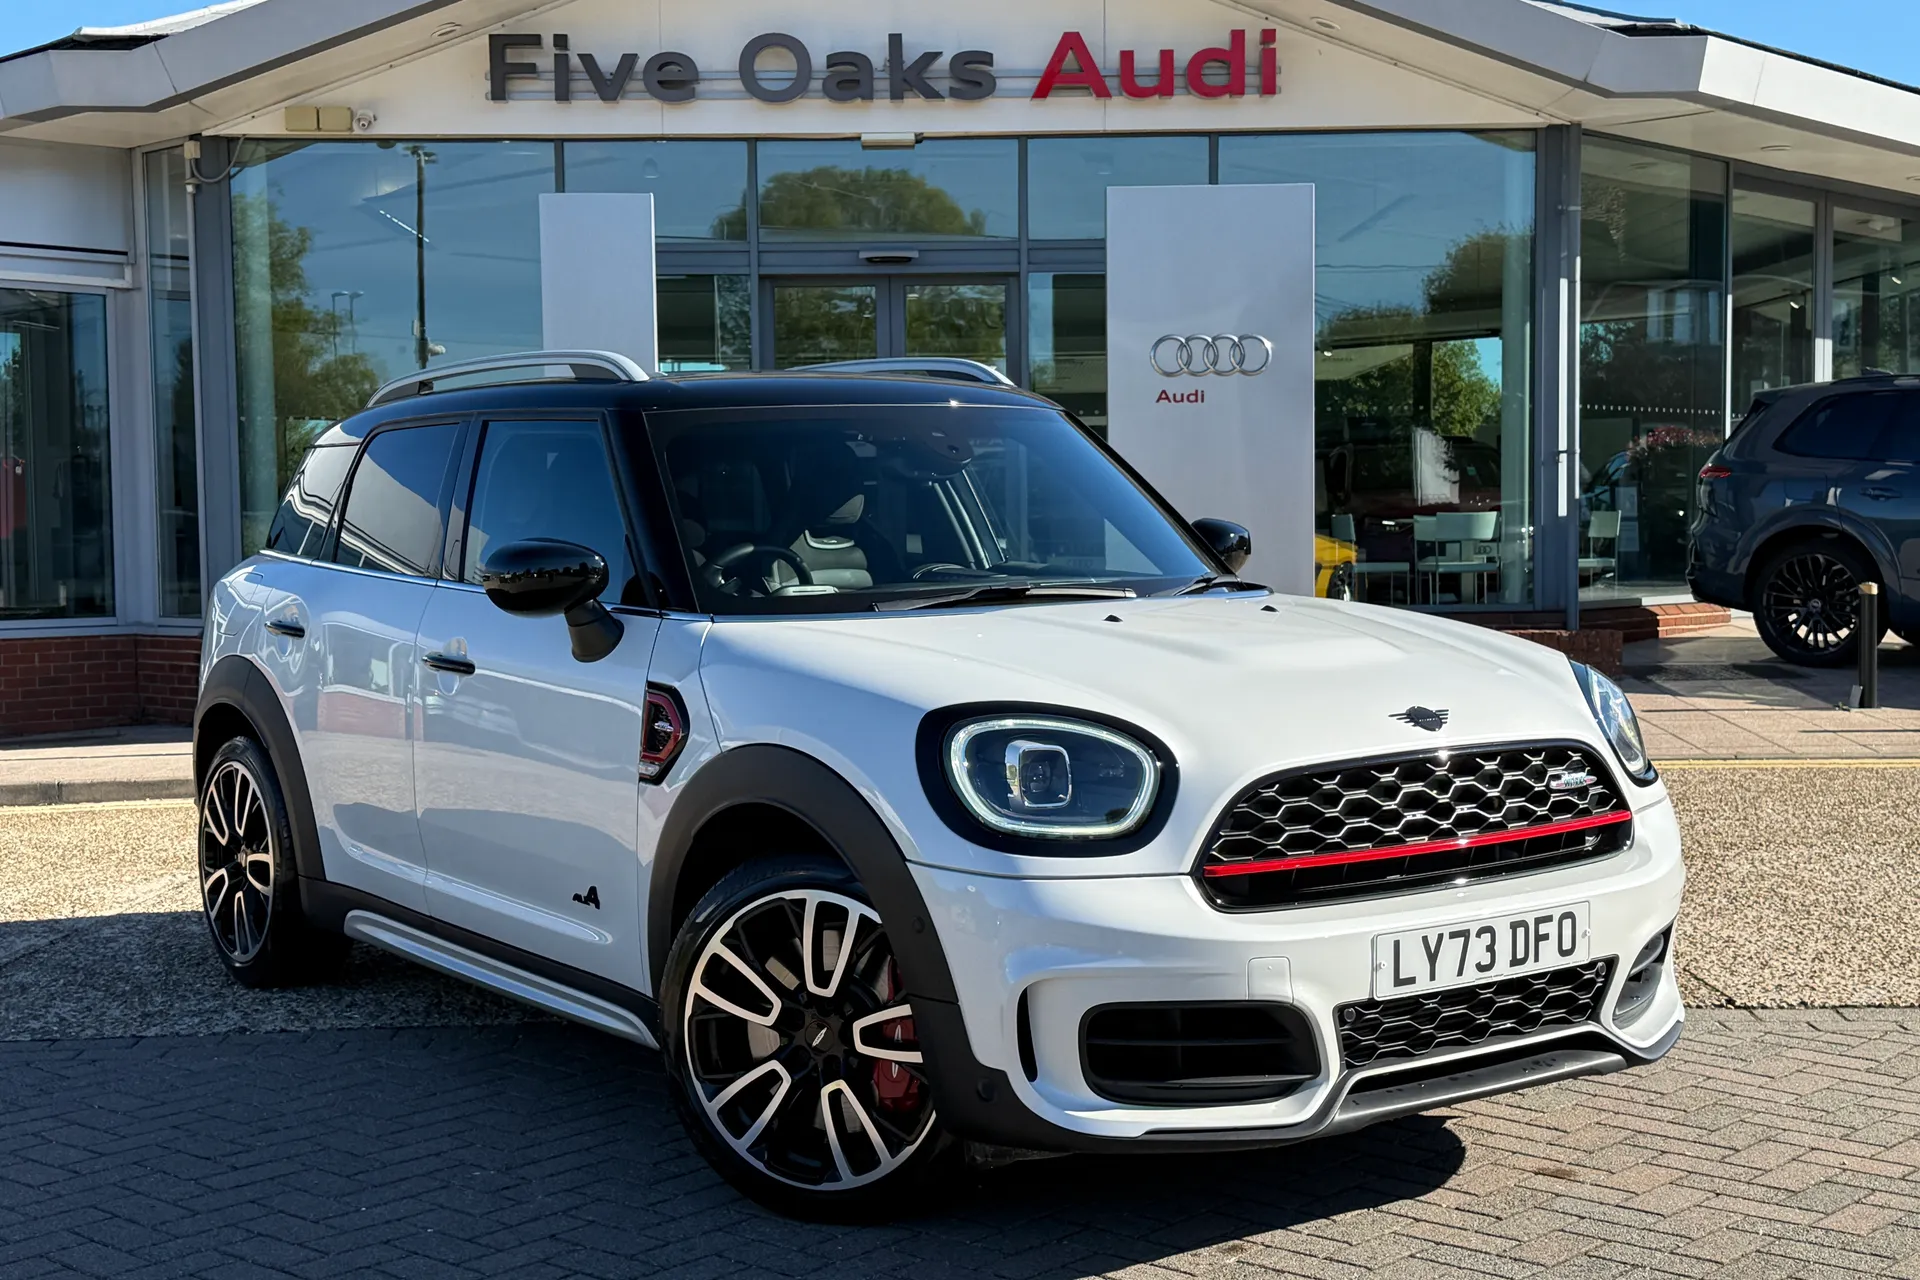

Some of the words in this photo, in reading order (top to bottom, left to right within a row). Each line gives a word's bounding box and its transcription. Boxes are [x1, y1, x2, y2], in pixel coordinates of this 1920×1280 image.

[489, 34, 699, 103] Five
[739, 32, 997, 103] Oaks
[1031, 28, 1277, 101] Audi
[1156, 389, 1205, 404] Audi
[1393, 925, 1497, 988] LY73
[1509, 911, 1577, 968] DFO
